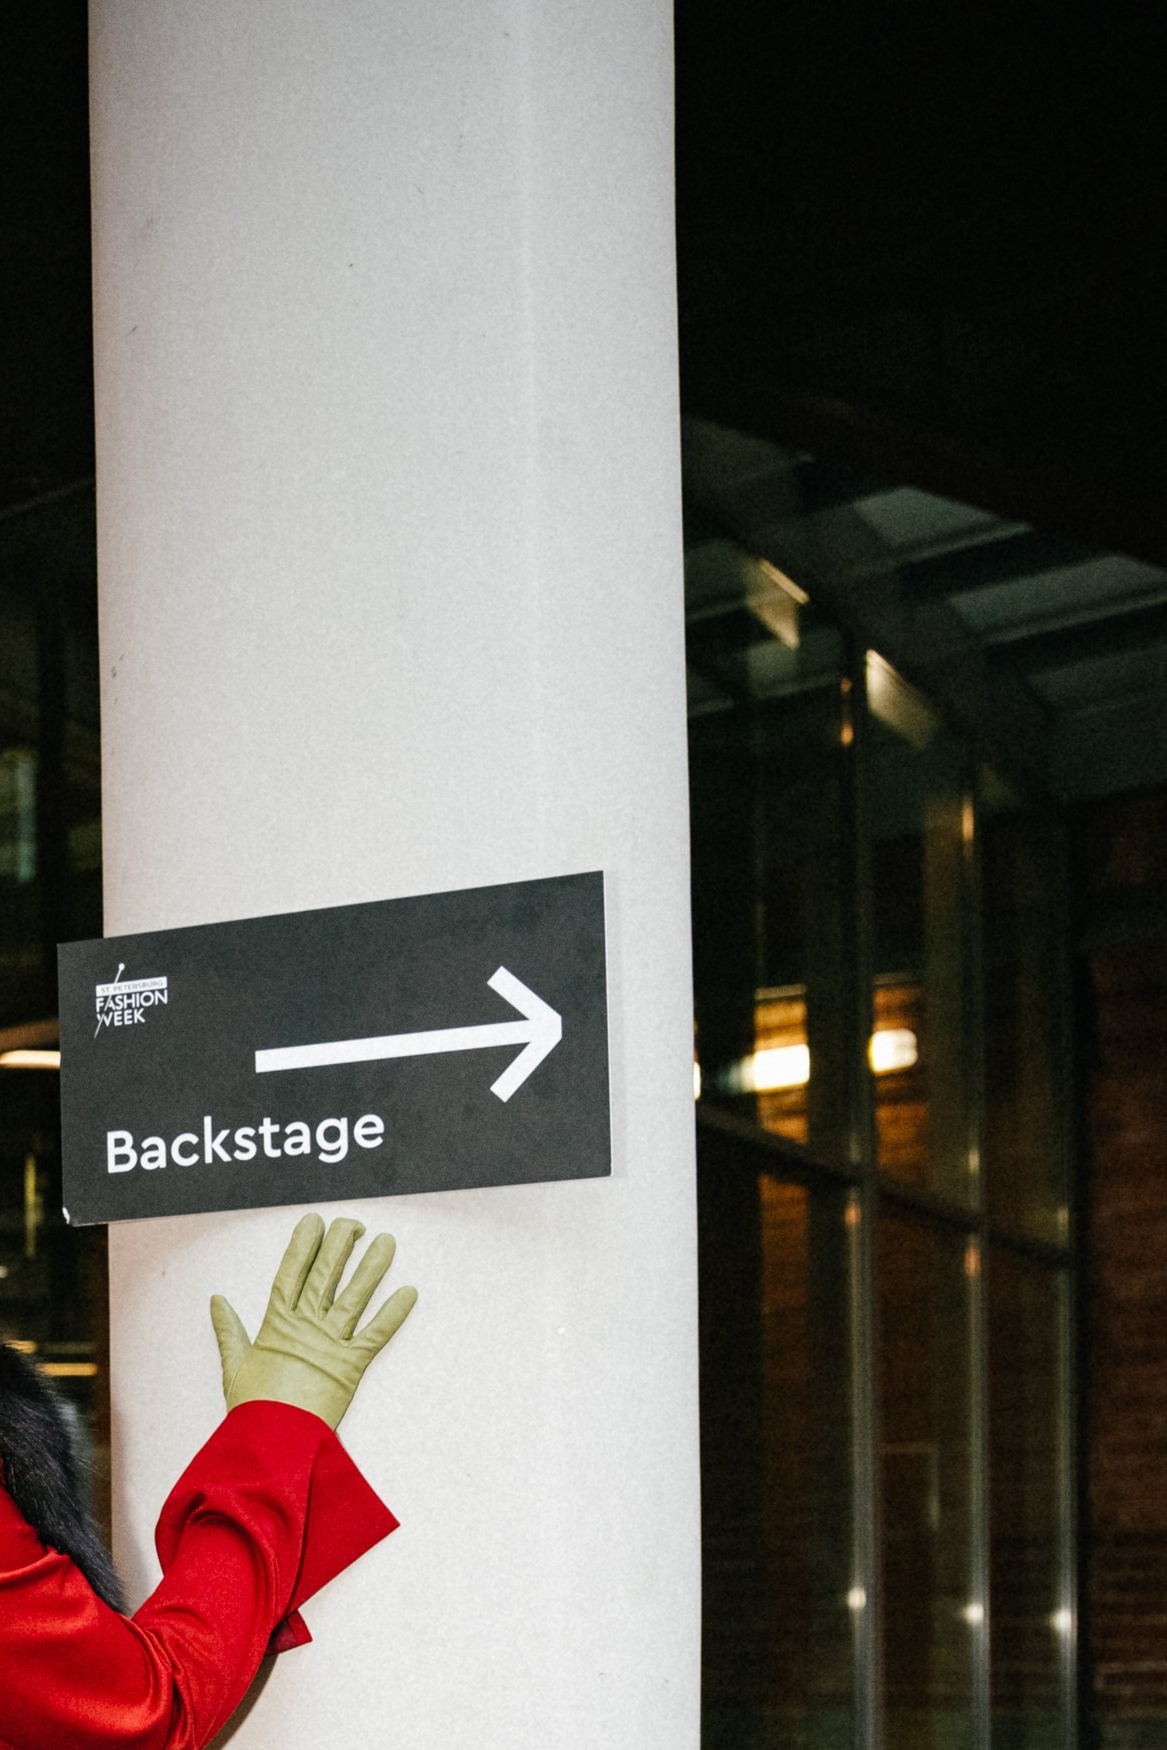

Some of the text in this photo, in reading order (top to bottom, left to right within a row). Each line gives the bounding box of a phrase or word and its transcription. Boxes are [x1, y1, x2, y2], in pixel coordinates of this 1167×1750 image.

[113, 980, 164, 992] PETERSBURG
[96, 989, 168, 1012] FASHION
[96, 1008, 146, 1027] WEEK
[107, 1114, 385, 1174] Backstage
